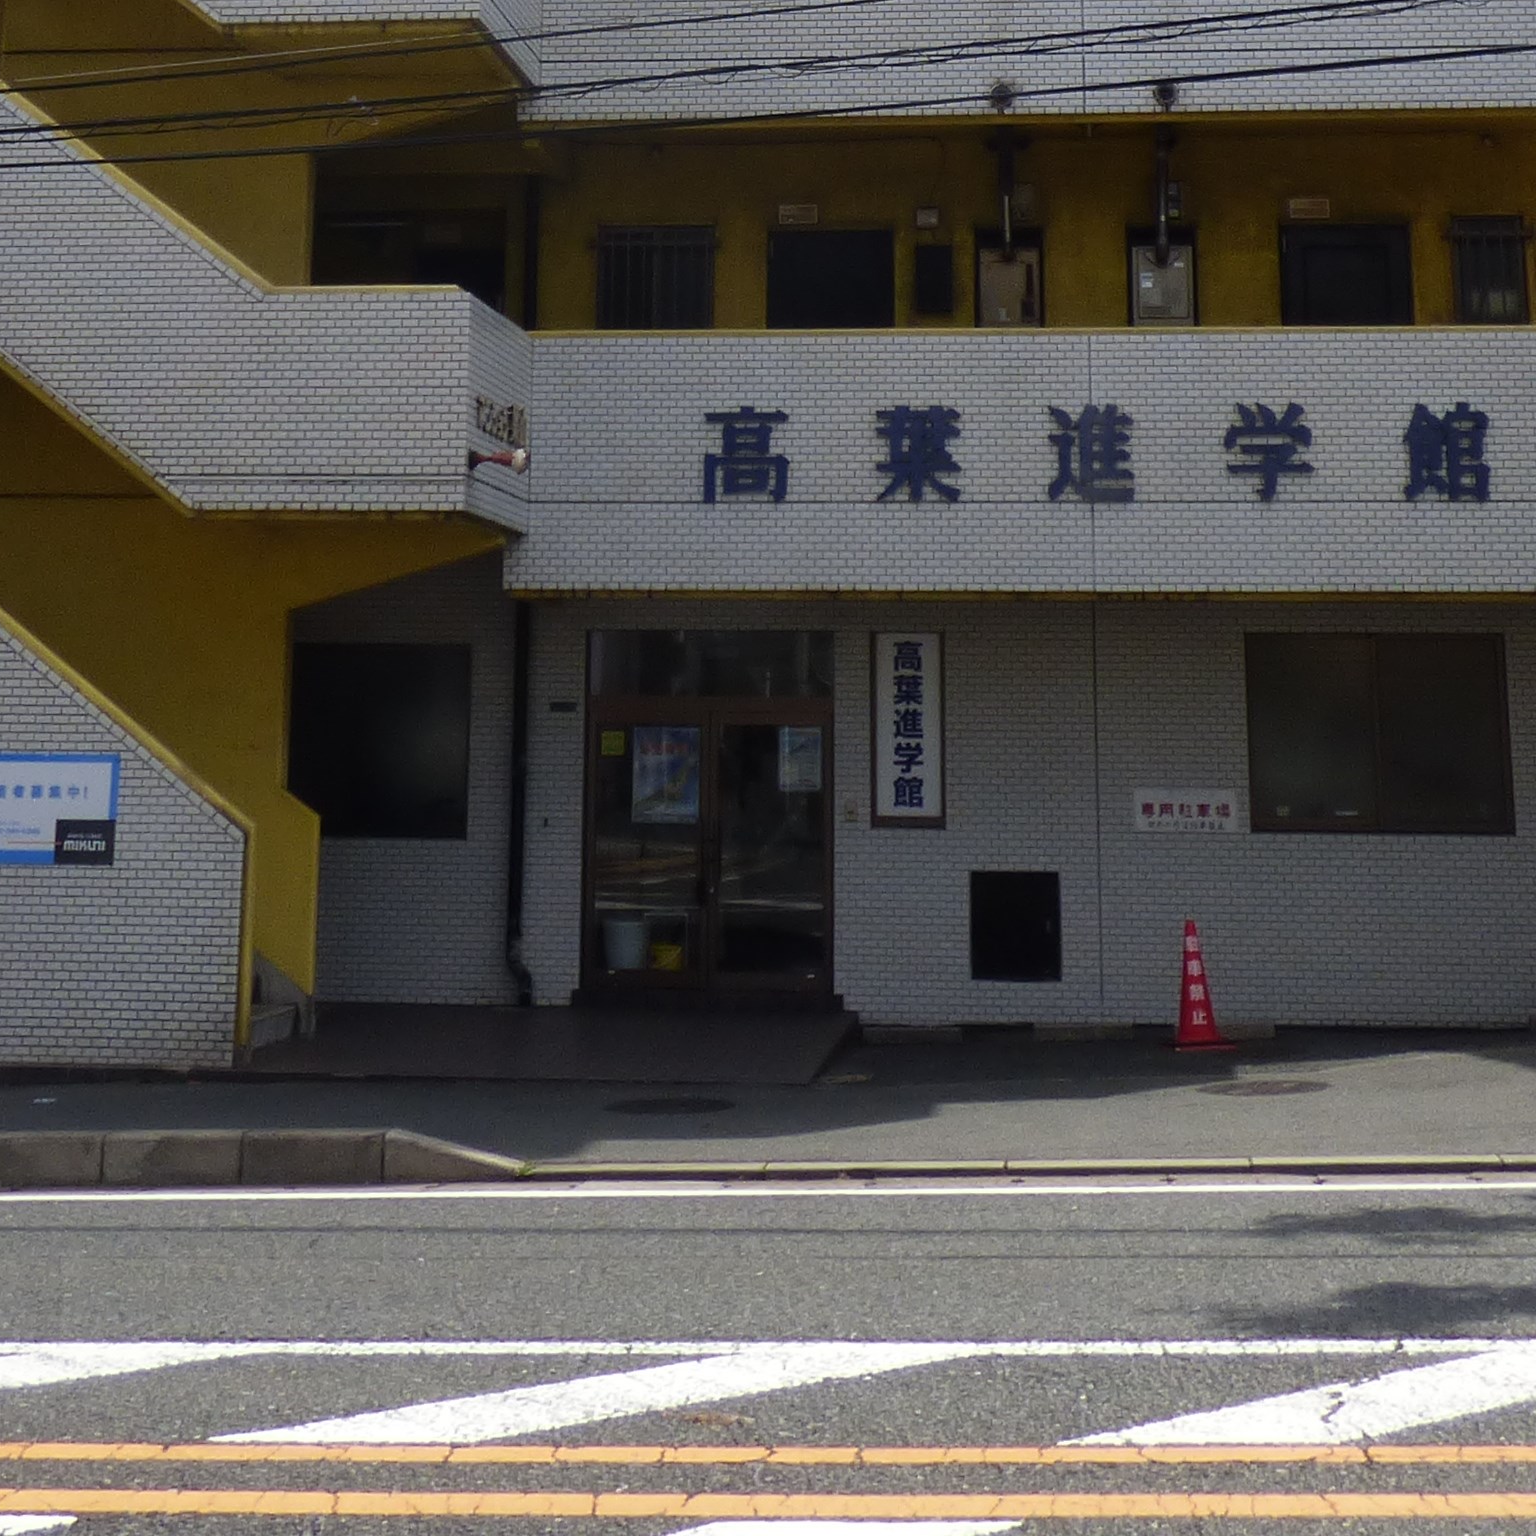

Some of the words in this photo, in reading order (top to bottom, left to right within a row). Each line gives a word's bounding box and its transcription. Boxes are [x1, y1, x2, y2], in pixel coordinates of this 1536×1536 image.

[701, 401, 1493, 505] 高葉進学館
[893, 640, 924, 808] 高葉進学館
[1141, 802, 1231, 819] 専用駐車場
[1184, 935, 1208, 1025] 駐車禁止
